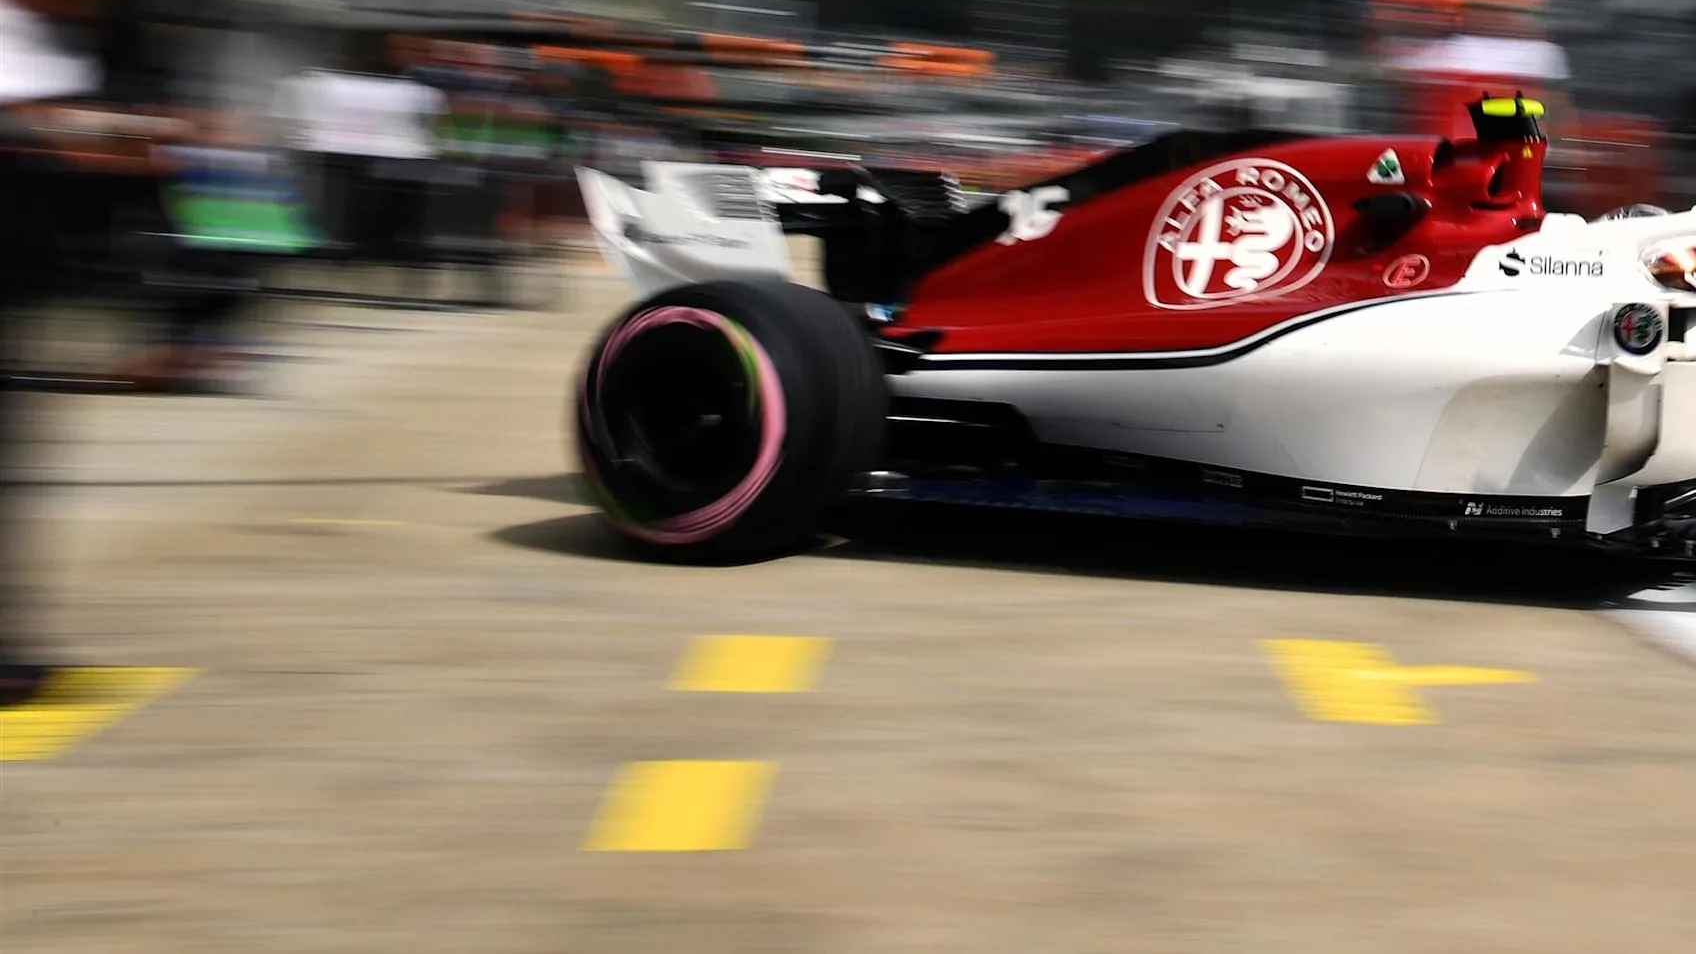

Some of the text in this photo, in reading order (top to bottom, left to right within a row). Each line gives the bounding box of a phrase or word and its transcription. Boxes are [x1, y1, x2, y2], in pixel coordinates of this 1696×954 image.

[1157, 166, 1325, 254] ALFA ROMEO
[1529, 255, 1604, 277] Silanna
[1486, 504, 1520, 516] Additive
